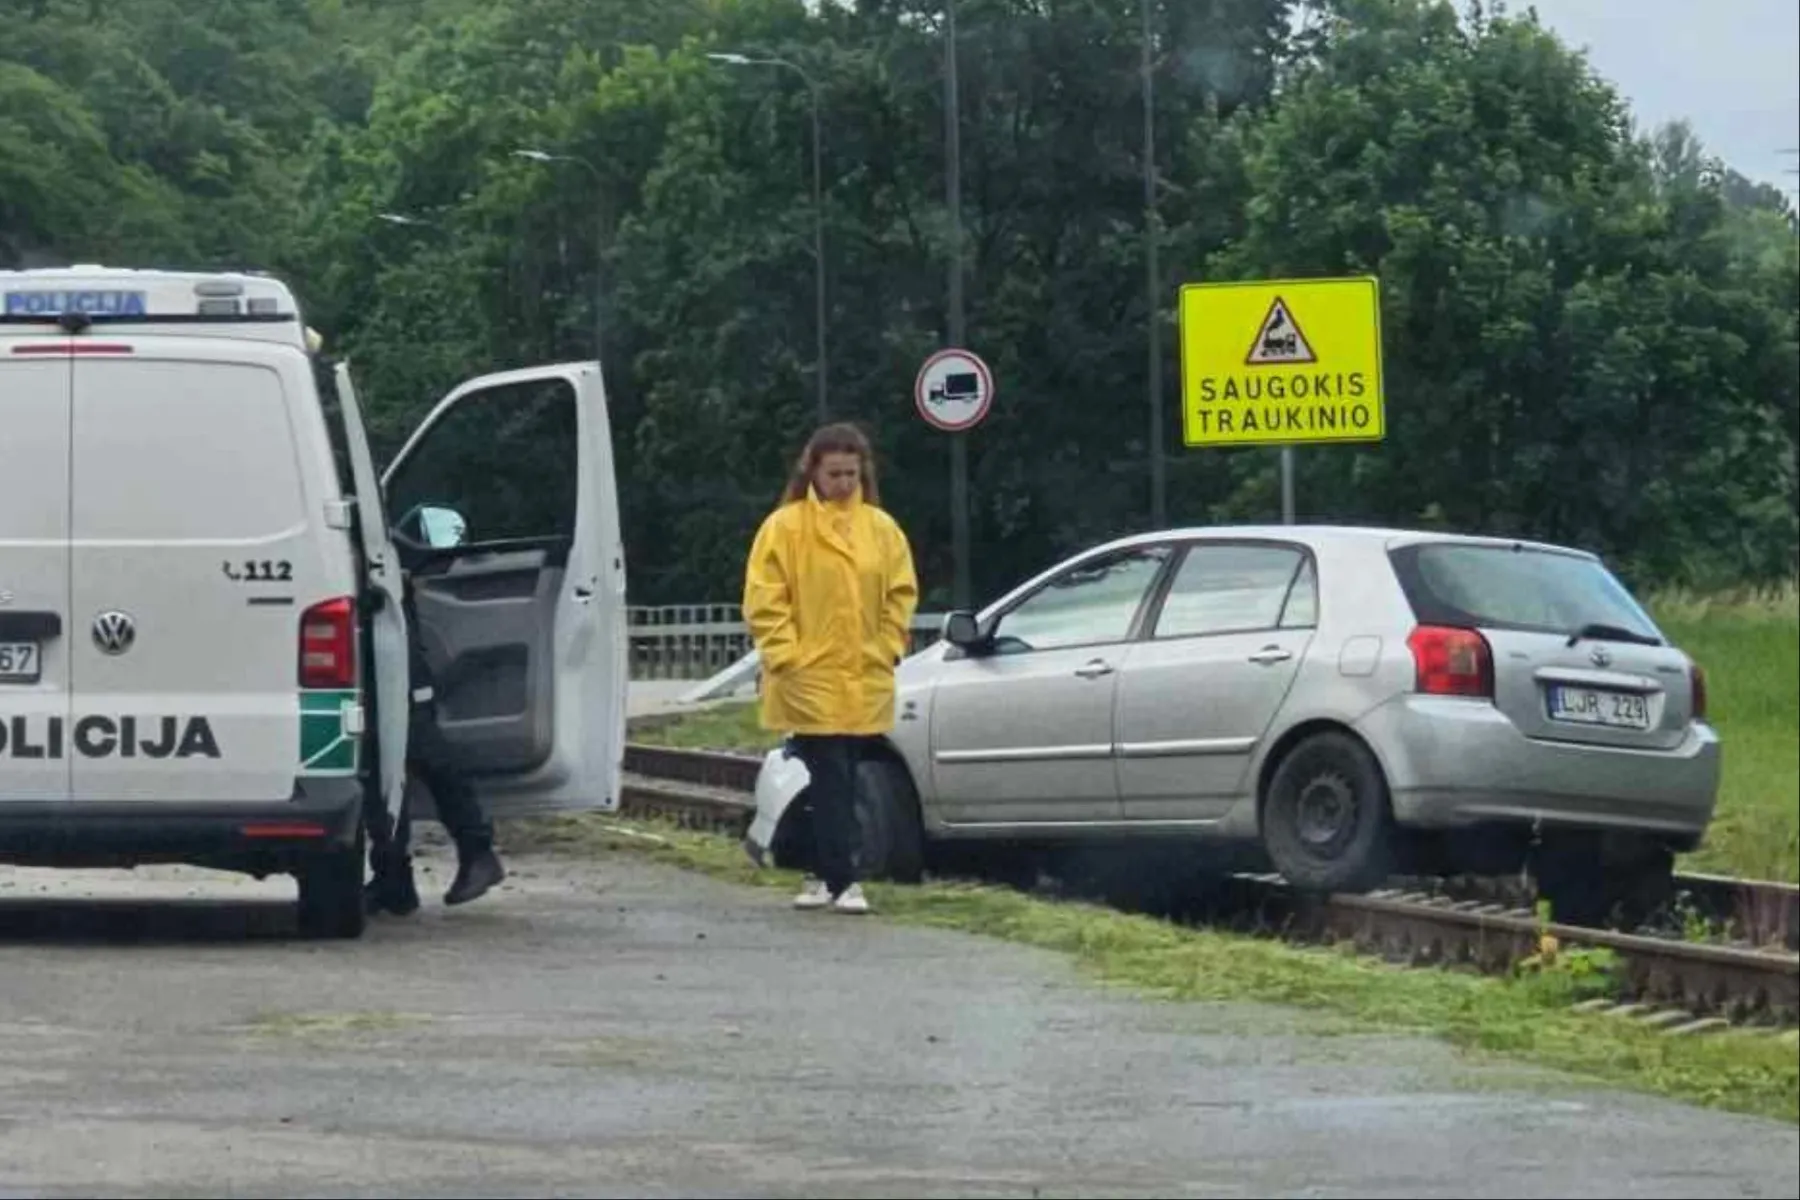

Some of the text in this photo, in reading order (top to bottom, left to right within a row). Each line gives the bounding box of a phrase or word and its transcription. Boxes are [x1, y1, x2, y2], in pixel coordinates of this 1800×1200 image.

[6, 289, 147, 315] POLICIJA
[1201, 373, 1365, 401] SAUGOKIS
[1198, 405, 1370, 433] TRAUKINIO
[244, 559, 293, 581] 112
[0, 714, 222, 759] LICIJA
